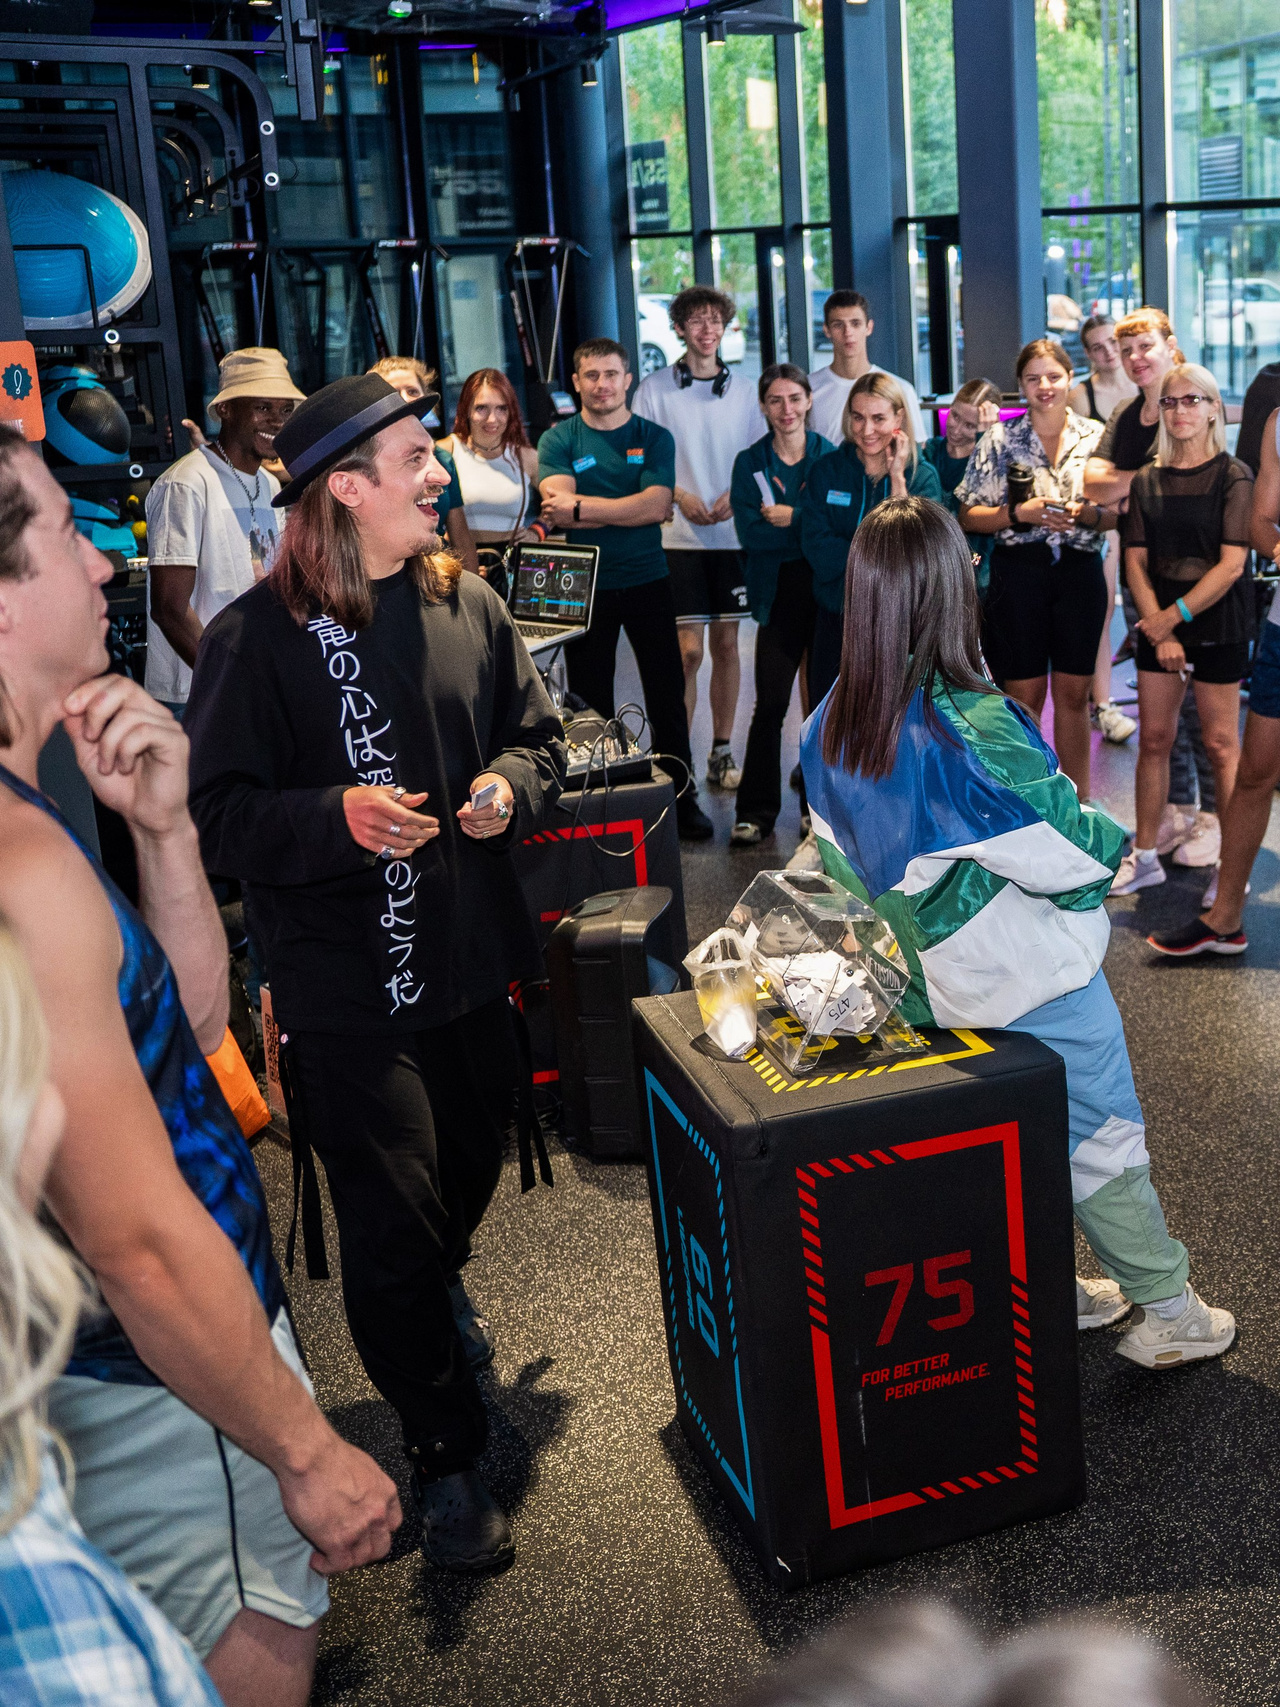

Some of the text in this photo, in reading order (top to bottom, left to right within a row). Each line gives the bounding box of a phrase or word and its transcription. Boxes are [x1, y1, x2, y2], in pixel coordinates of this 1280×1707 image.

[828, 997, 850, 1021] 475
[689, 1233, 720, 1359] 60
[864, 1249, 975, 1347] 75
[861, 1353, 950, 1388] FOR BETTER
[884, 1362, 991, 1402] PERFORMANCE.
